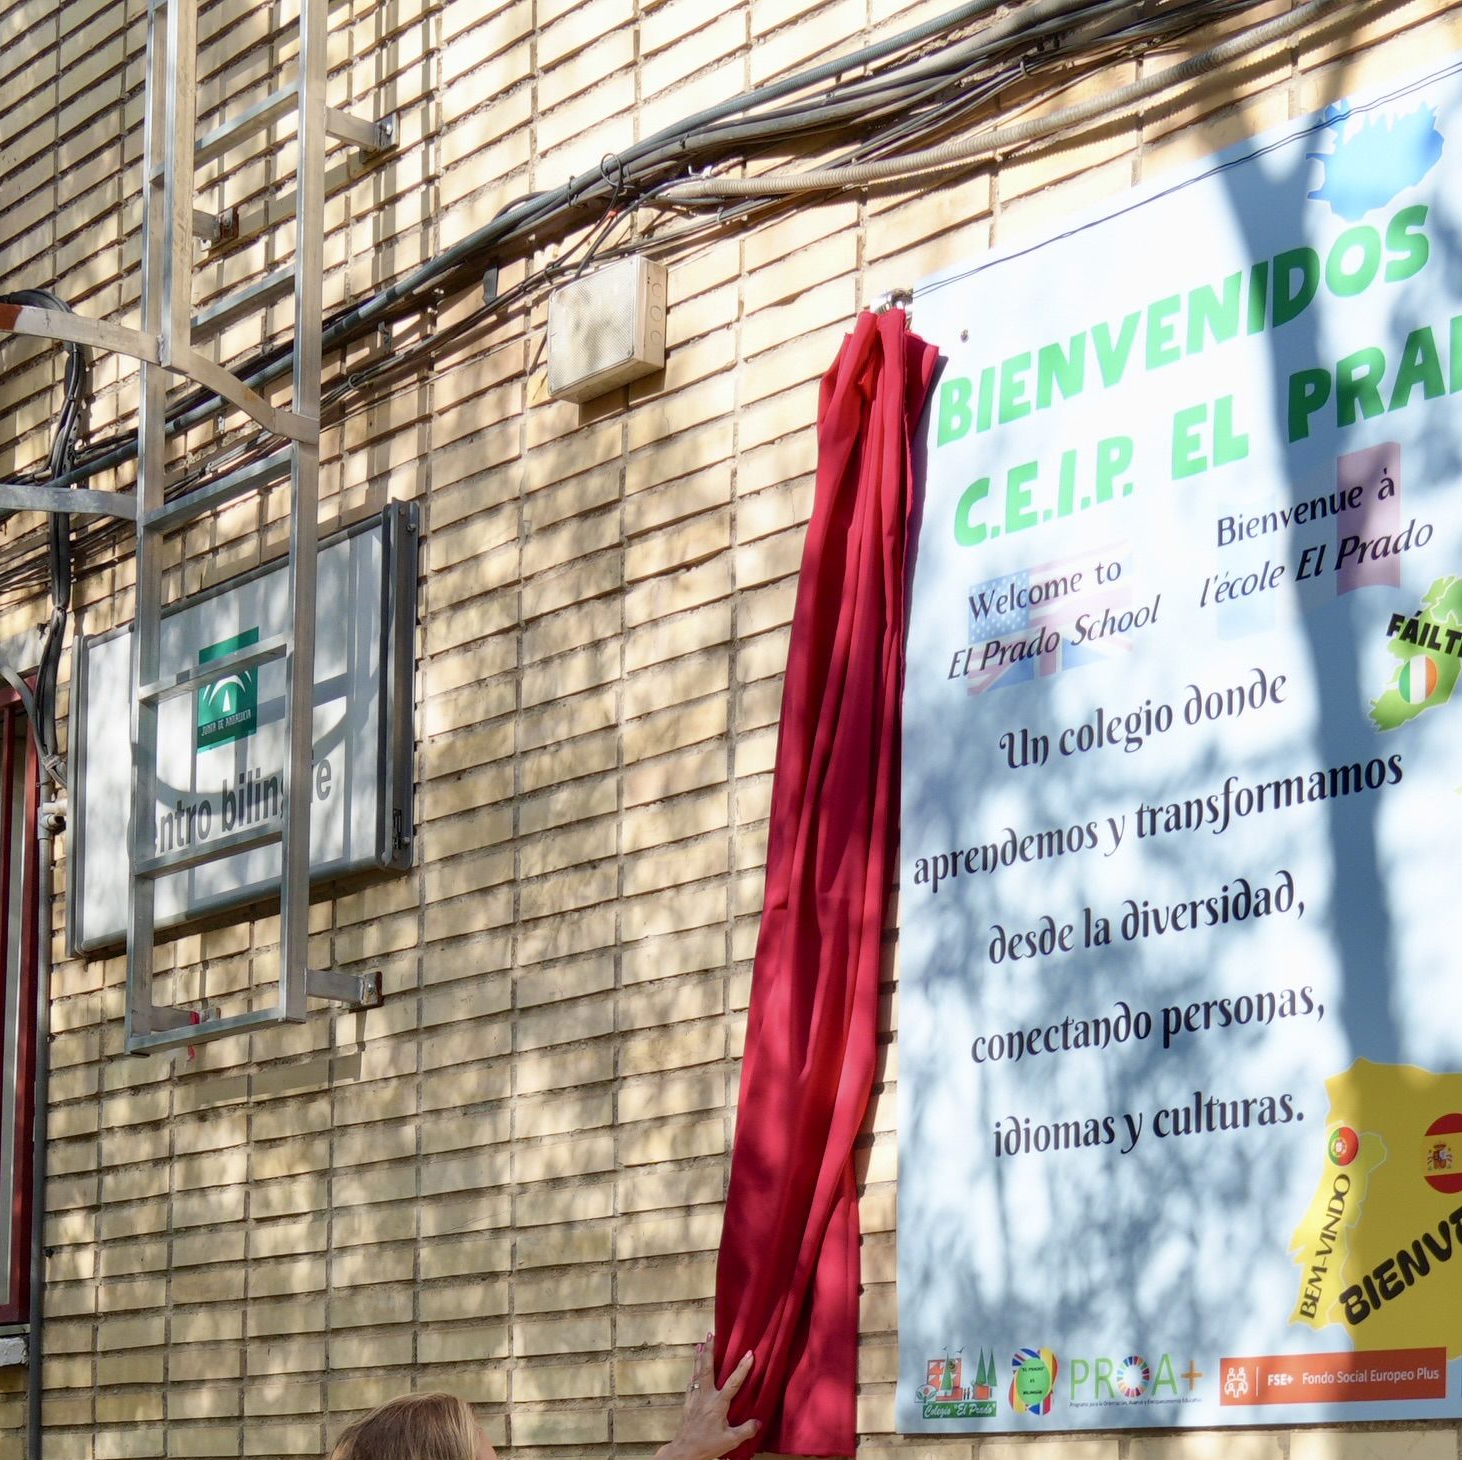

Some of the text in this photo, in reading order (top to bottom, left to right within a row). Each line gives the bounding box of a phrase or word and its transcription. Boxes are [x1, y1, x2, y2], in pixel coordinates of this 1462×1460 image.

[936, 203, 1429, 448] BIENVENIDOS
[952, 435, 1135, 548] C.E.I.P.
[1171, 395, 1249, 480] EL
[1216, 467, 1396, 548] Bienvenue à
[968, 561, 1122, 622] Welcome to
[1200, 520, 1435, 608] l'école El Prado
[947, 594, 1161, 680] El Prado School
[999, 667, 1287, 770] Un colegio donde
[222, 757, 332, 832] biline
[912, 752, 1405, 893] aprendemos y transformamos
[987, 868, 1306, 966] desde la diversidad,
[970, 982, 1326, 1064] conectando personas,
[992, 1090, 1305, 1159] idiomas y culturas.
[1299, 1173, 1351, 1319] BEM-VINDO
[924, 1405, 950, 1418] Colegio
[1268, 1367, 1440, 1386] FSE+ Fondo Social Europeo Plus
